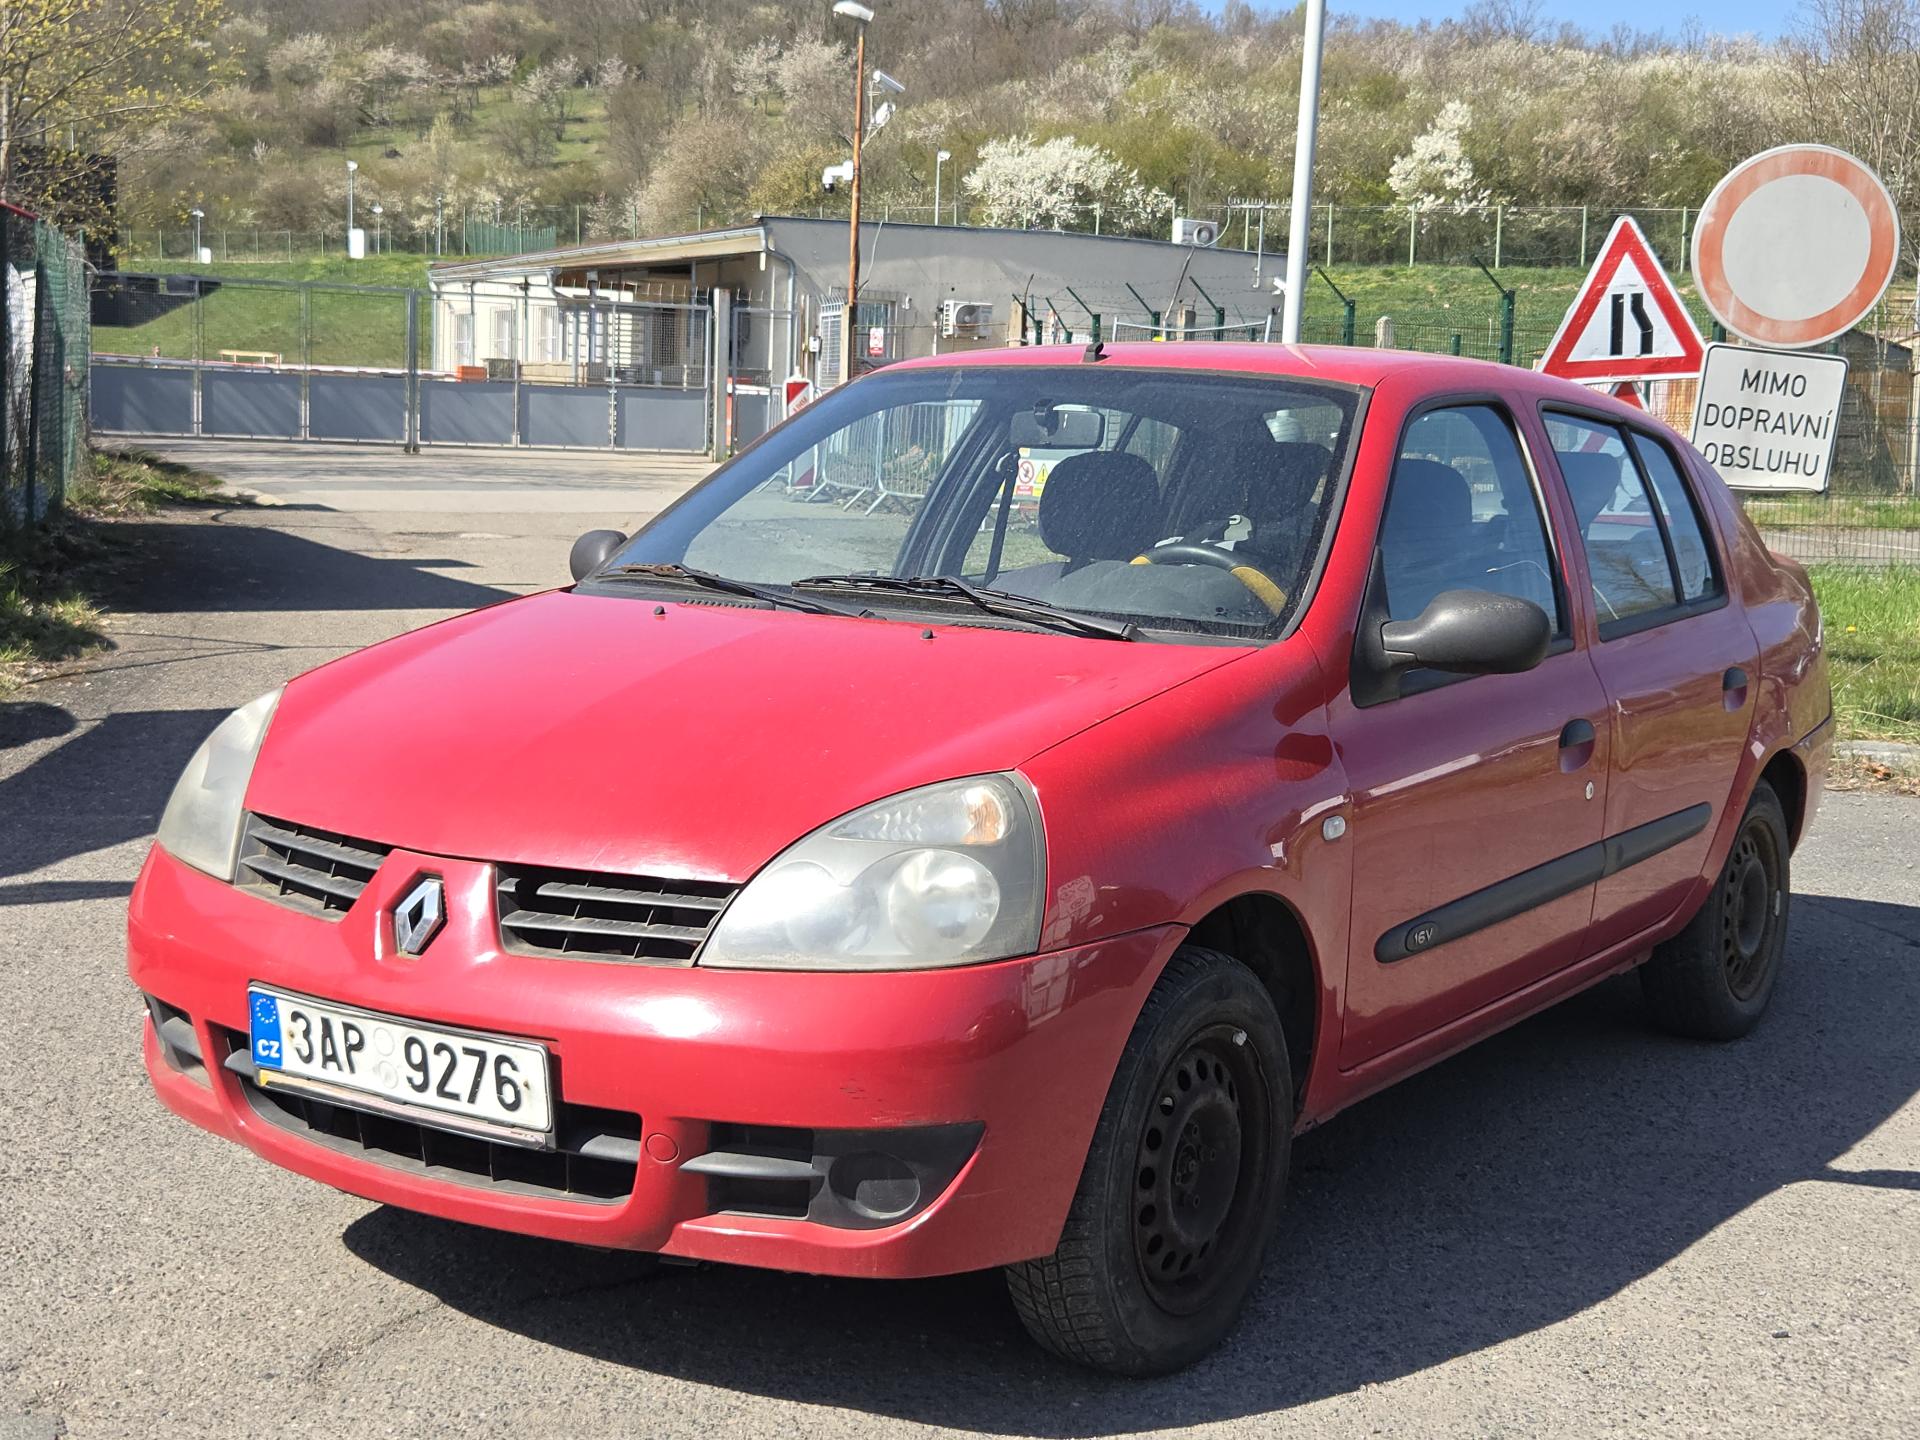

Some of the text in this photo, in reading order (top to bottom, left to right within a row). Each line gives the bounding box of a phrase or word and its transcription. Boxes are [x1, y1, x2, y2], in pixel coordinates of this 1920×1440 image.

[1740, 368, 1807, 398] MIMO
[1703, 403, 1833, 440] DOPRAVNÍ
[1703, 442, 1820, 477] OBSLUHU
[1414, 928, 1433, 945] 16V
[257, 1038, 281, 1059] CZ
[290, 1010, 522, 1112] 3AP 9276
